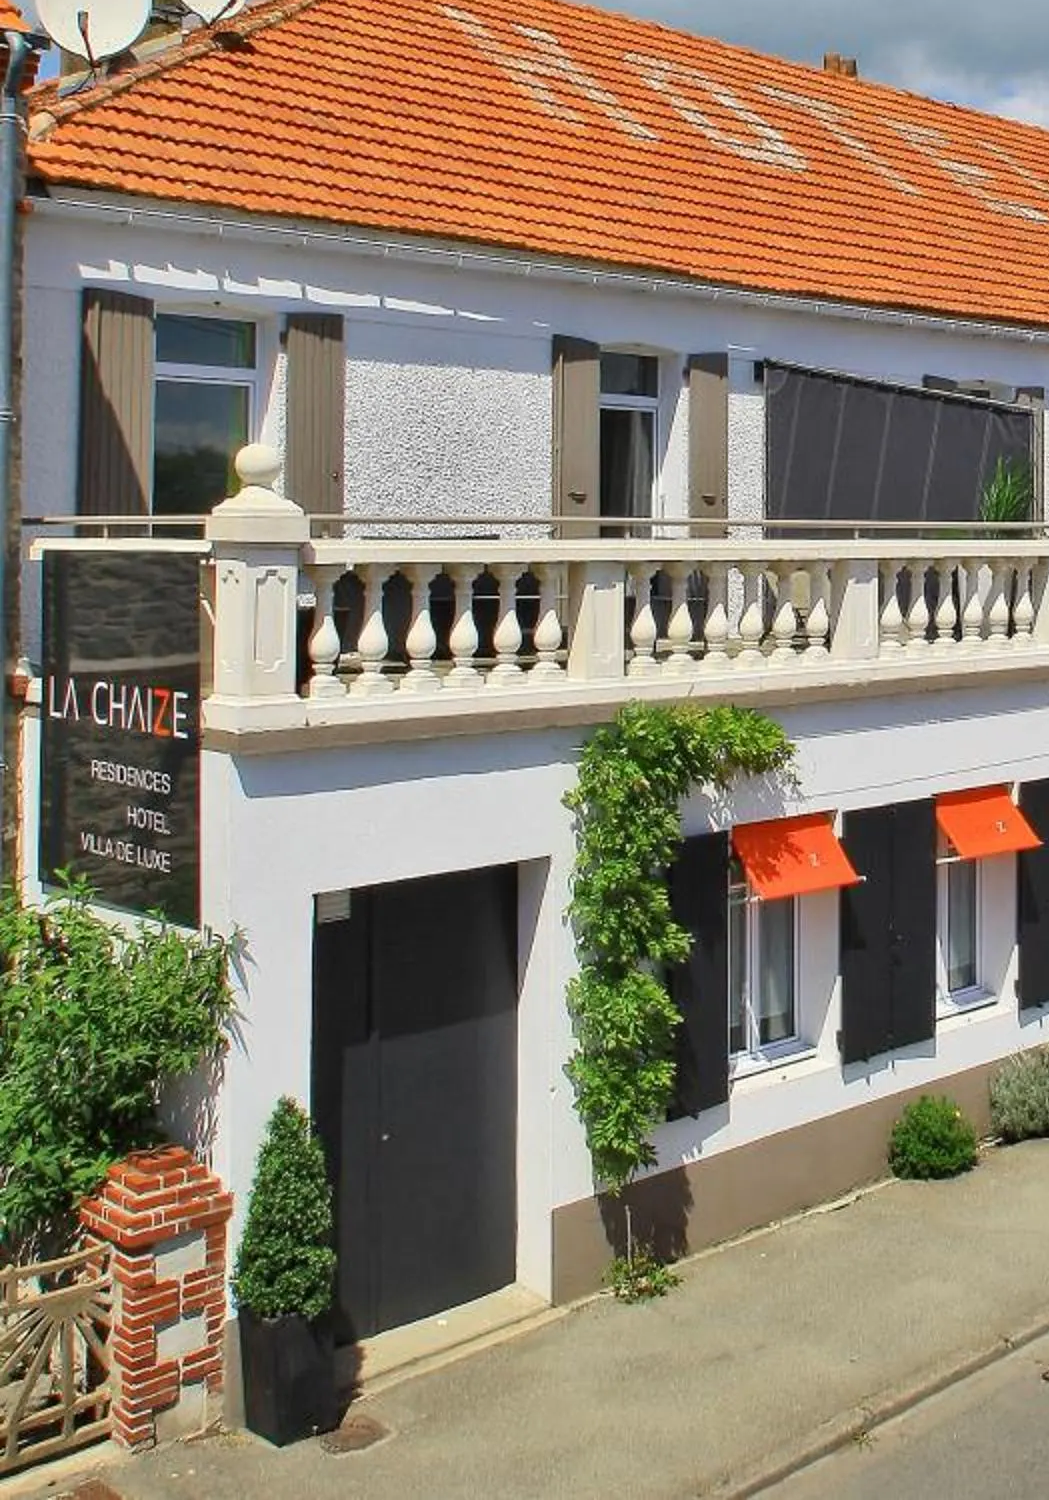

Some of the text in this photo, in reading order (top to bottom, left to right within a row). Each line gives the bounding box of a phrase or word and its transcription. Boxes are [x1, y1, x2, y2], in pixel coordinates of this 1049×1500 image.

[49, 675, 189, 739] LA CHAIZE
[91, 759, 171, 794] RESIDENCES
[127, 805, 171, 835] HOTEL
[81, 832, 171, 873] VILLA DE LUXE
